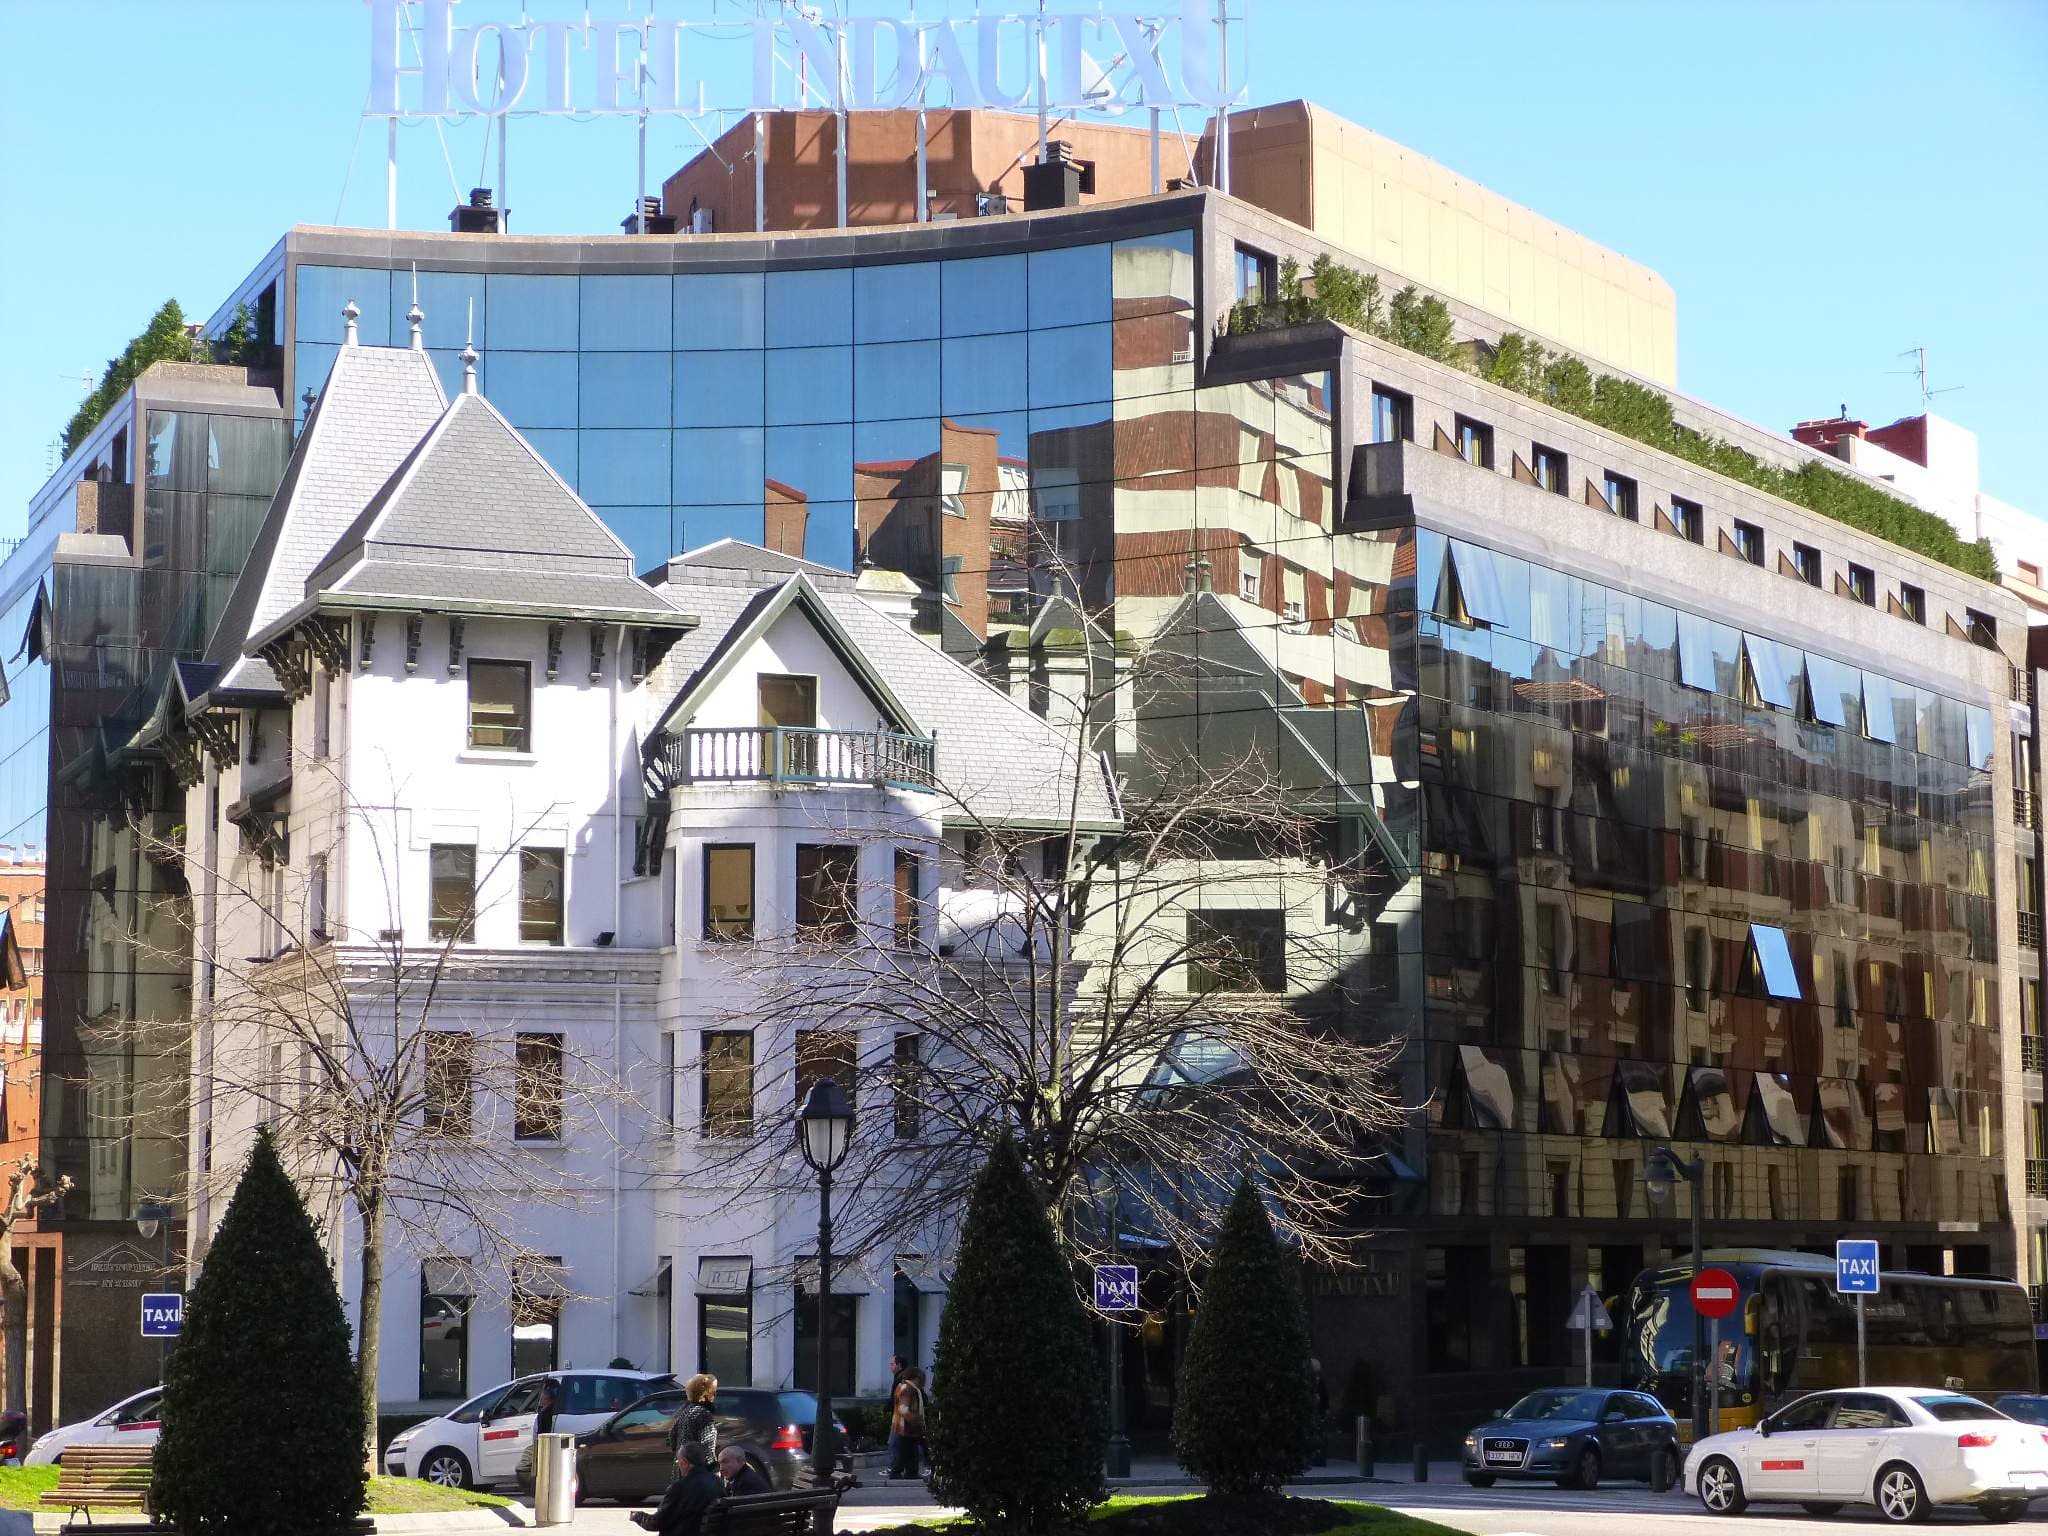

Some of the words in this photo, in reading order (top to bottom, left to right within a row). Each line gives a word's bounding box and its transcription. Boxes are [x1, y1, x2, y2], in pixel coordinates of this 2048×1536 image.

[361, 0, 702, 116] HOTEL
[745, 0, 1249, 111] INDAUTXU
[1840, 1258, 1875, 1275] TAXI
[1097, 1281, 1135, 1295] TAXI
[144, 1308, 178, 1322] TAXI
